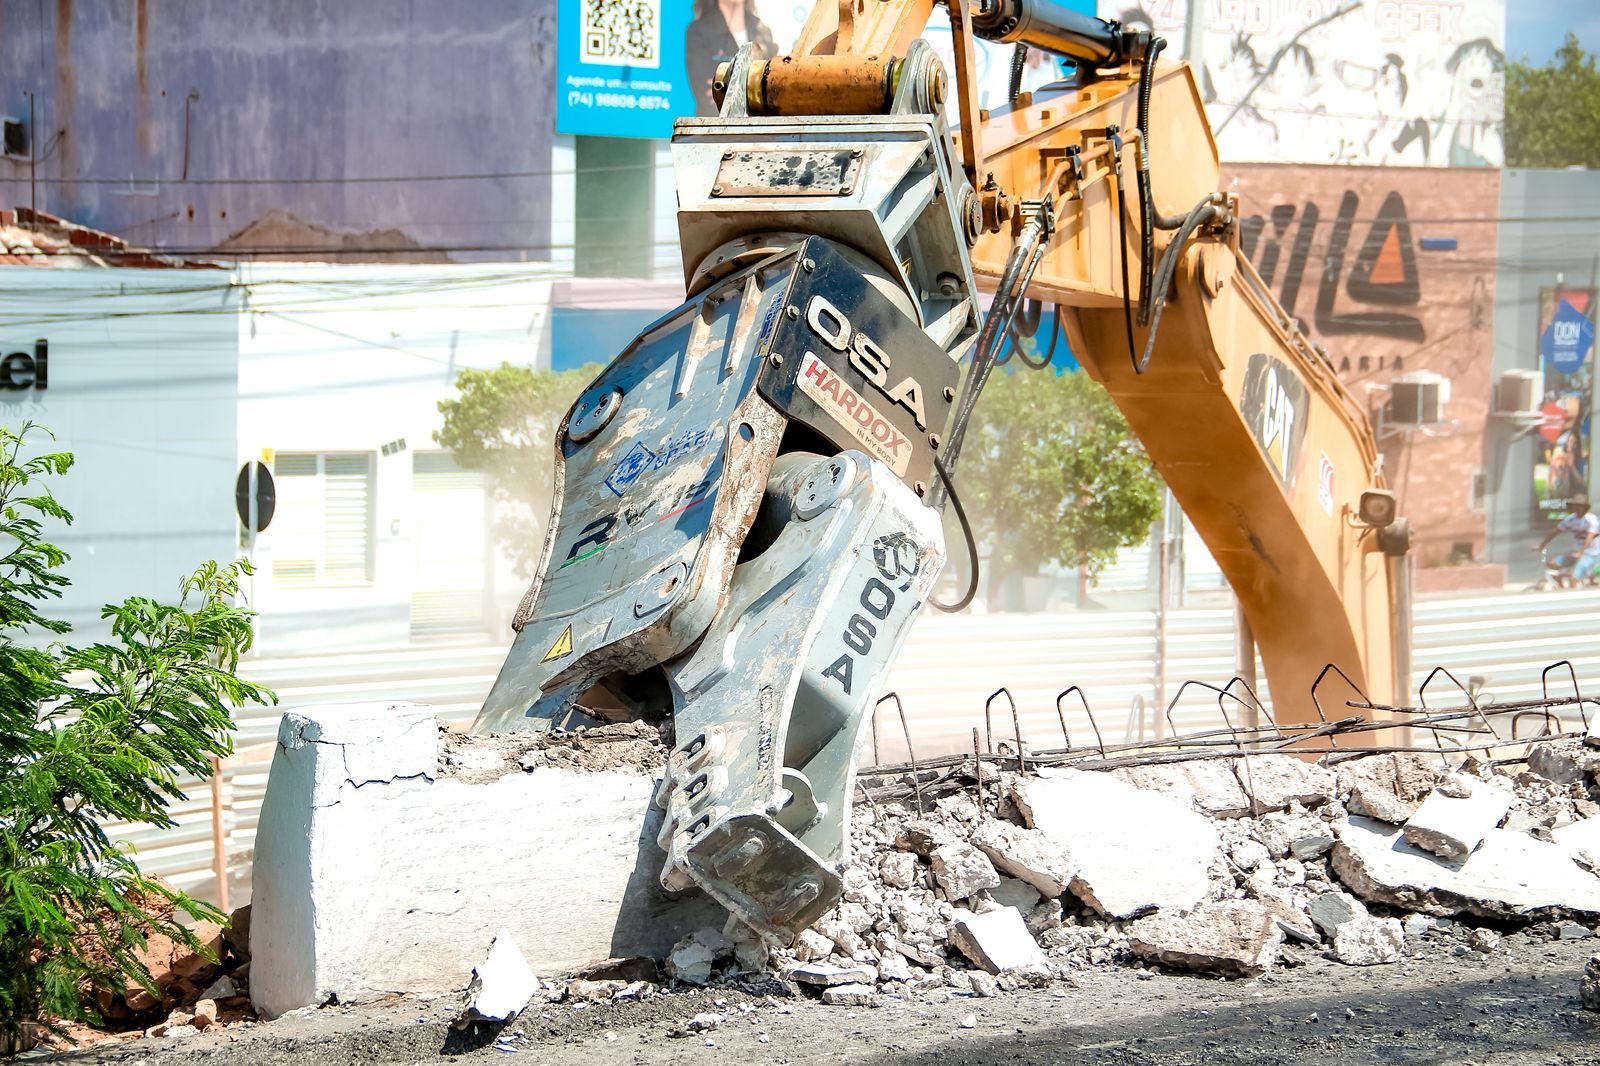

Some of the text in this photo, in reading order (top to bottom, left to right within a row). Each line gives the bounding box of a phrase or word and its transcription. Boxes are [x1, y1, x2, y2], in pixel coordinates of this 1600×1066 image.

[0, 338, 48, 391] el
[806, 295, 926, 431] OSA
[856, 429, 896, 466] IN MY BODY
[1262, 367, 1295, 482] CAT
[821, 577, 896, 696] OSA
